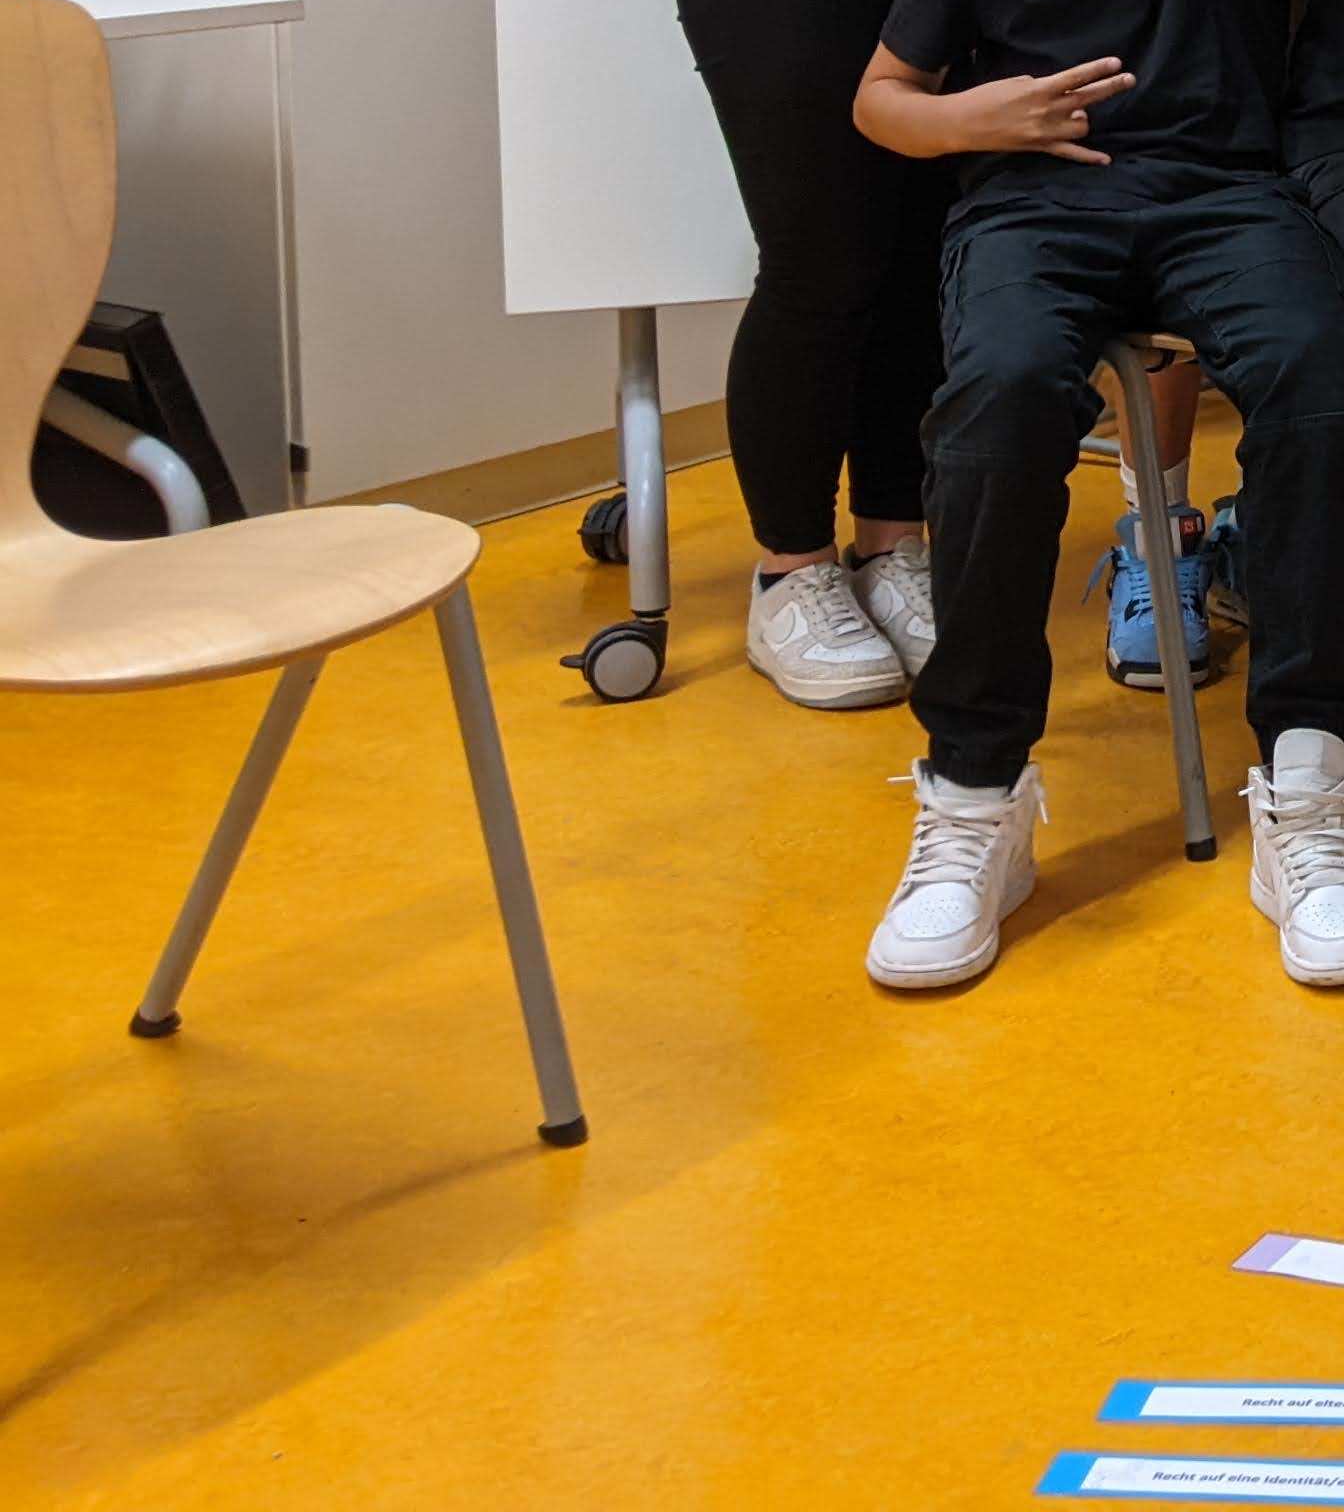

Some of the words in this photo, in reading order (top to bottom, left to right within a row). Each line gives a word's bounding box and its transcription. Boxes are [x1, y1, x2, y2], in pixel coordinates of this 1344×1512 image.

[1241, 1397, 1284, 1406] Recht
[1286, 1398, 1313, 1407] auf
[1151, 1471, 1196, 1481] Recht
[1198, 1472, 1226, 1482] auf
[1226, 1473, 1260, 1483] eine
